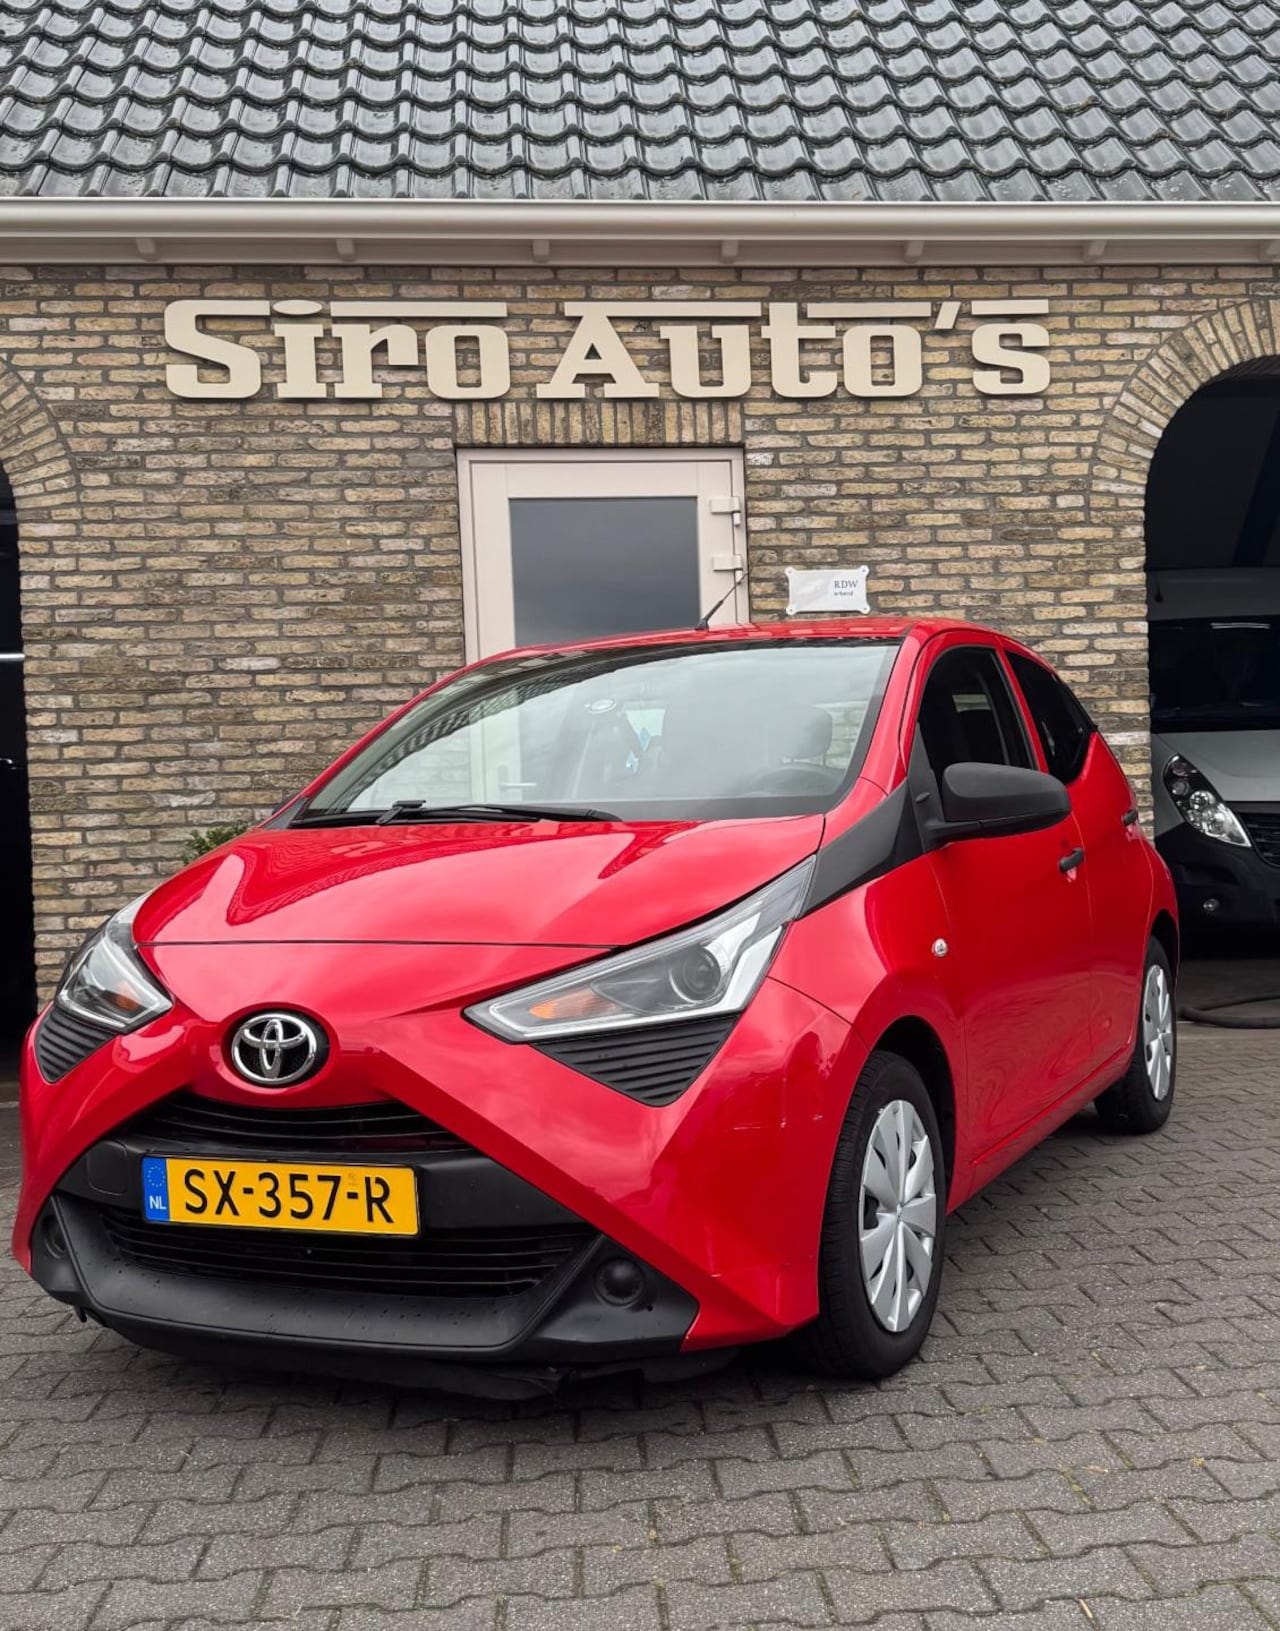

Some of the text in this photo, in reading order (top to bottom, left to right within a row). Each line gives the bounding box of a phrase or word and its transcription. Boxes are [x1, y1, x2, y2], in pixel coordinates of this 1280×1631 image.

[164, 299, 1051, 400] Siro Auto's
[834, 580, 858, 588] RDW
[149, 1195, 167, 1210] NL
[184, 1168, 394, 1223] SX-357-R
